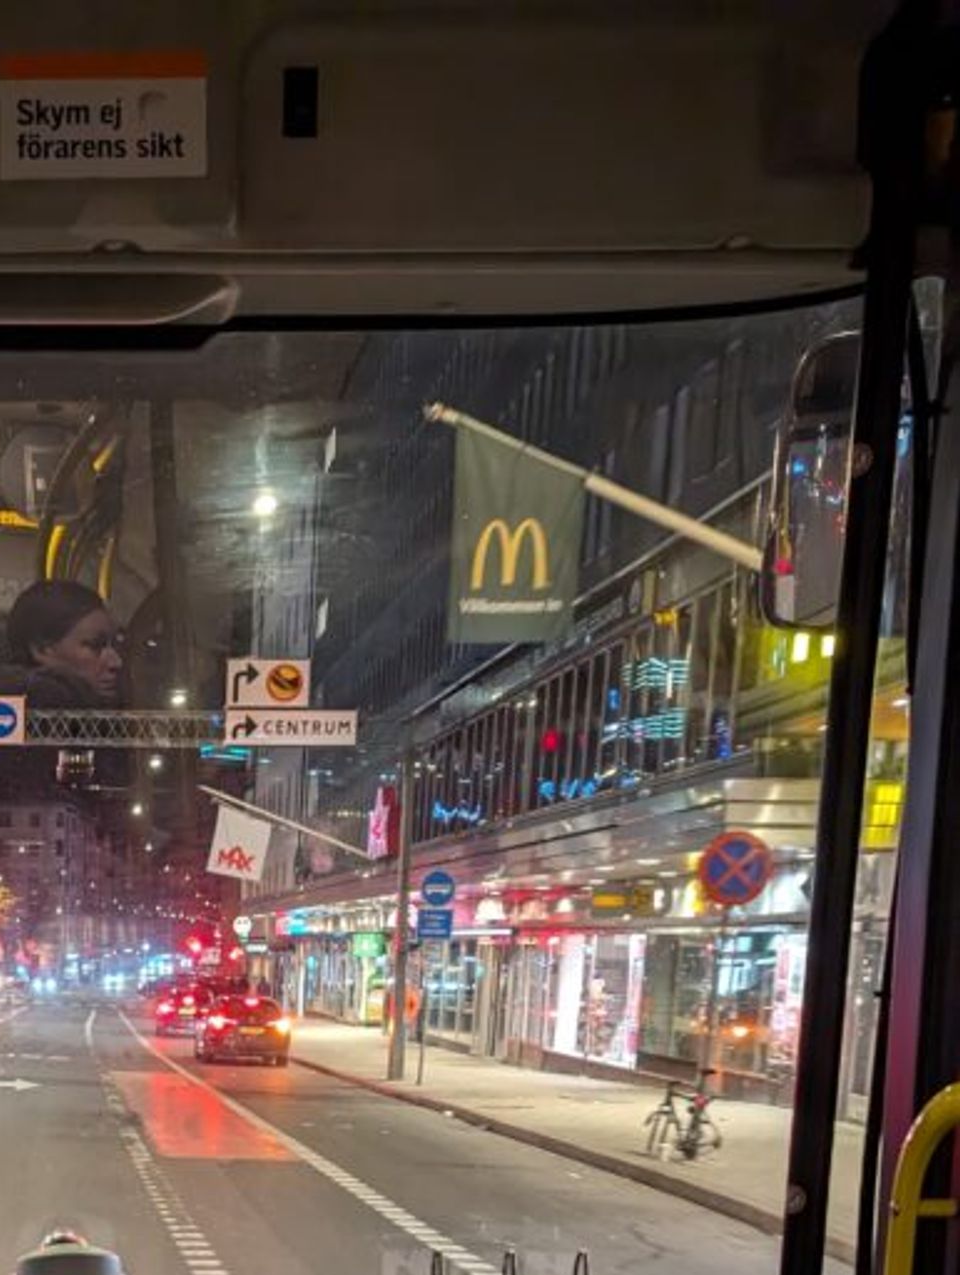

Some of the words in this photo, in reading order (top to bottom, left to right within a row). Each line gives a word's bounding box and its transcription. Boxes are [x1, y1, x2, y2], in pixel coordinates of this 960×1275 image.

[16, 99, 91, 131] Skym
[100, 98, 123, 131] ej
[16, 133, 127, 160] förarens
[136, 132, 185, 160] sikt
[262, 719, 353, 736] CENTRUM
[217, 845, 256, 873] MAX
